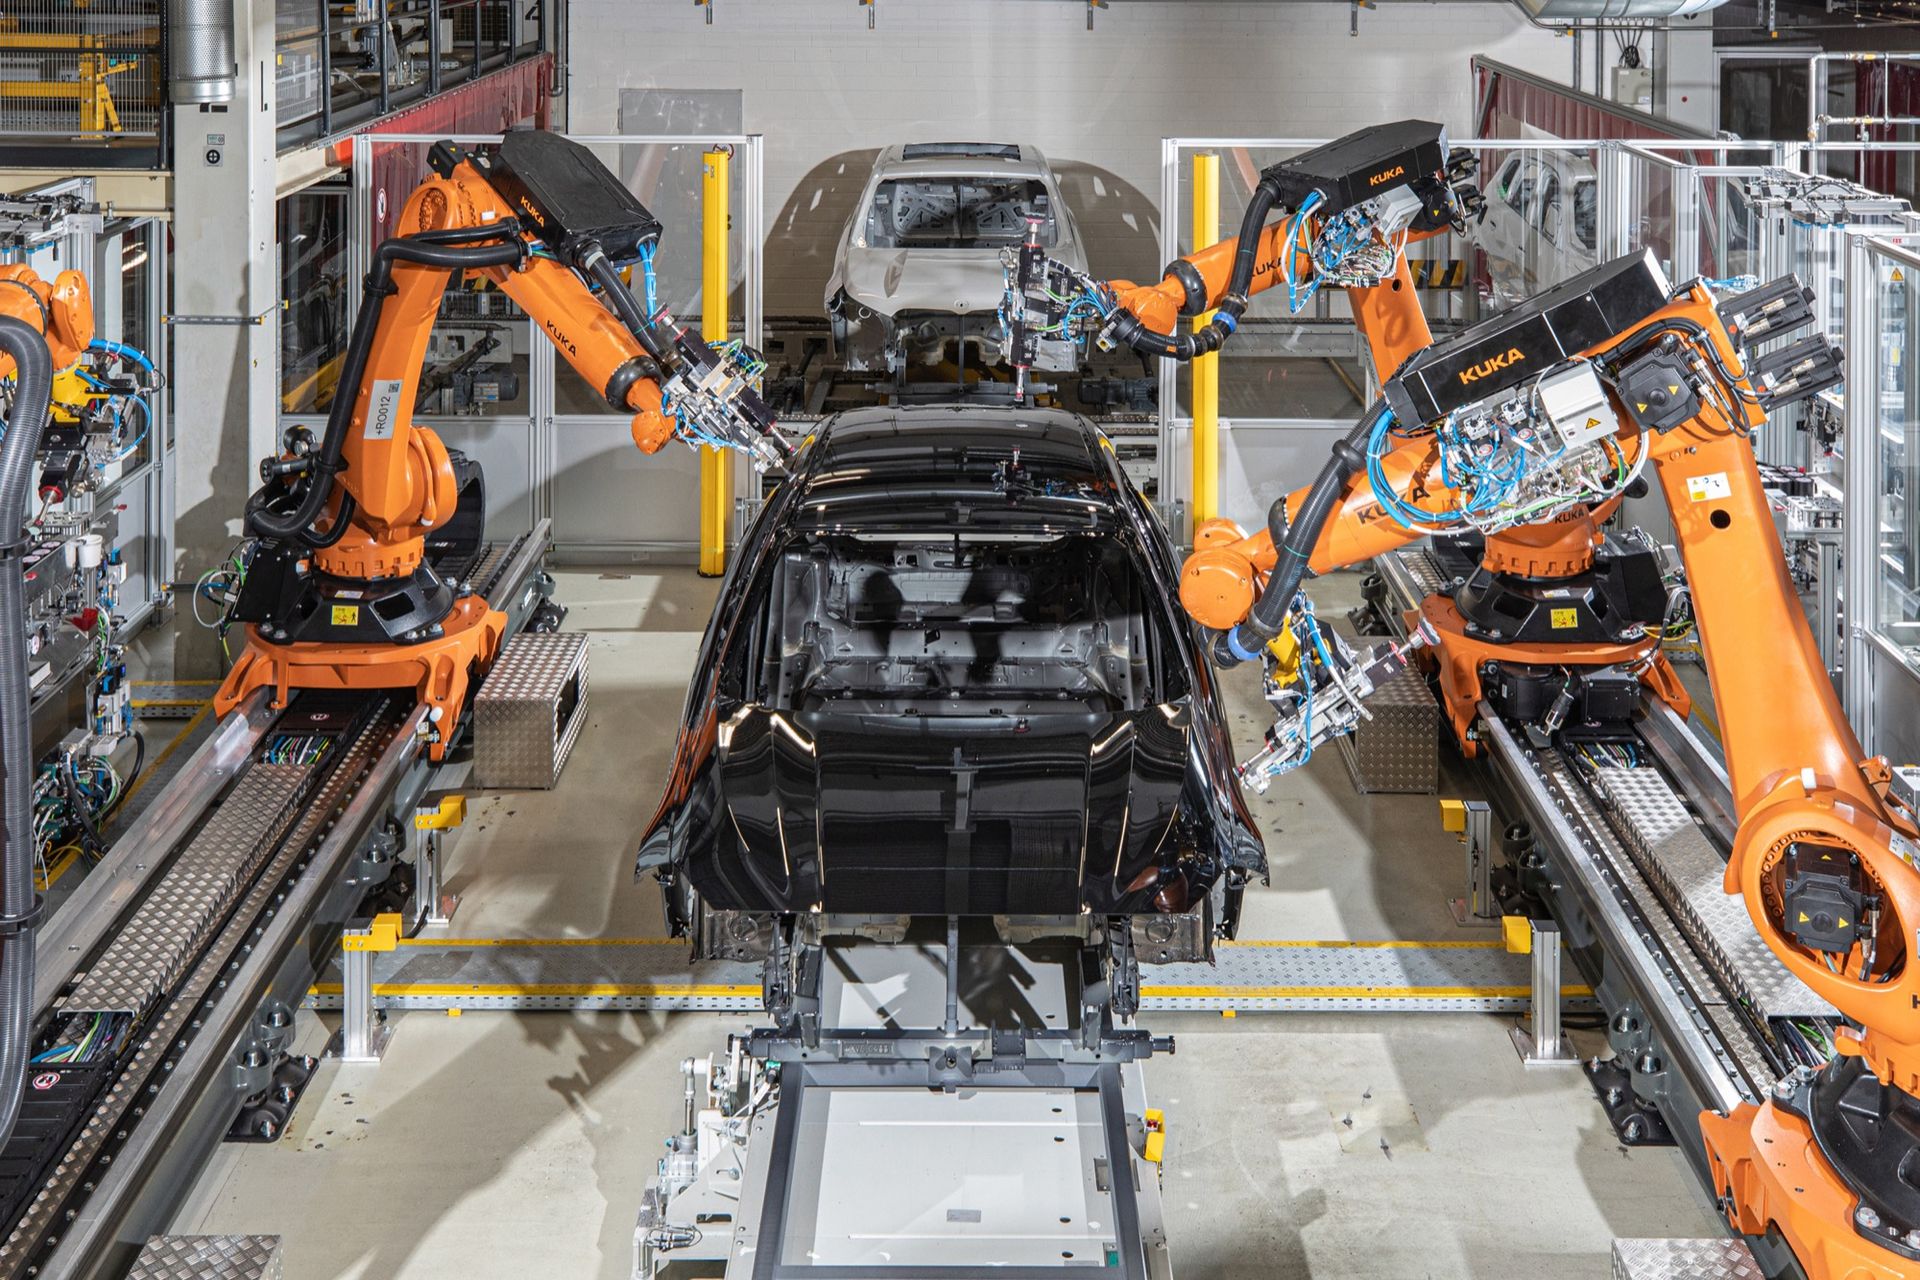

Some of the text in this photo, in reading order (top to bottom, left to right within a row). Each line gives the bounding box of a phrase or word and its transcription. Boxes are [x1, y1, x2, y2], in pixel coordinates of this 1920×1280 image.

[1369, 165, 1404, 186] KUKA
[520, 195, 545, 227] KUKA
[1251, 256, 1287, 277] UKA
[546, 319, 577, 357] KUKA
[1458, 347, 1526, 385] KUKA
[1356, 487, 1430, 525] KUA
[1554, 508, 1585, 524] KUKA
